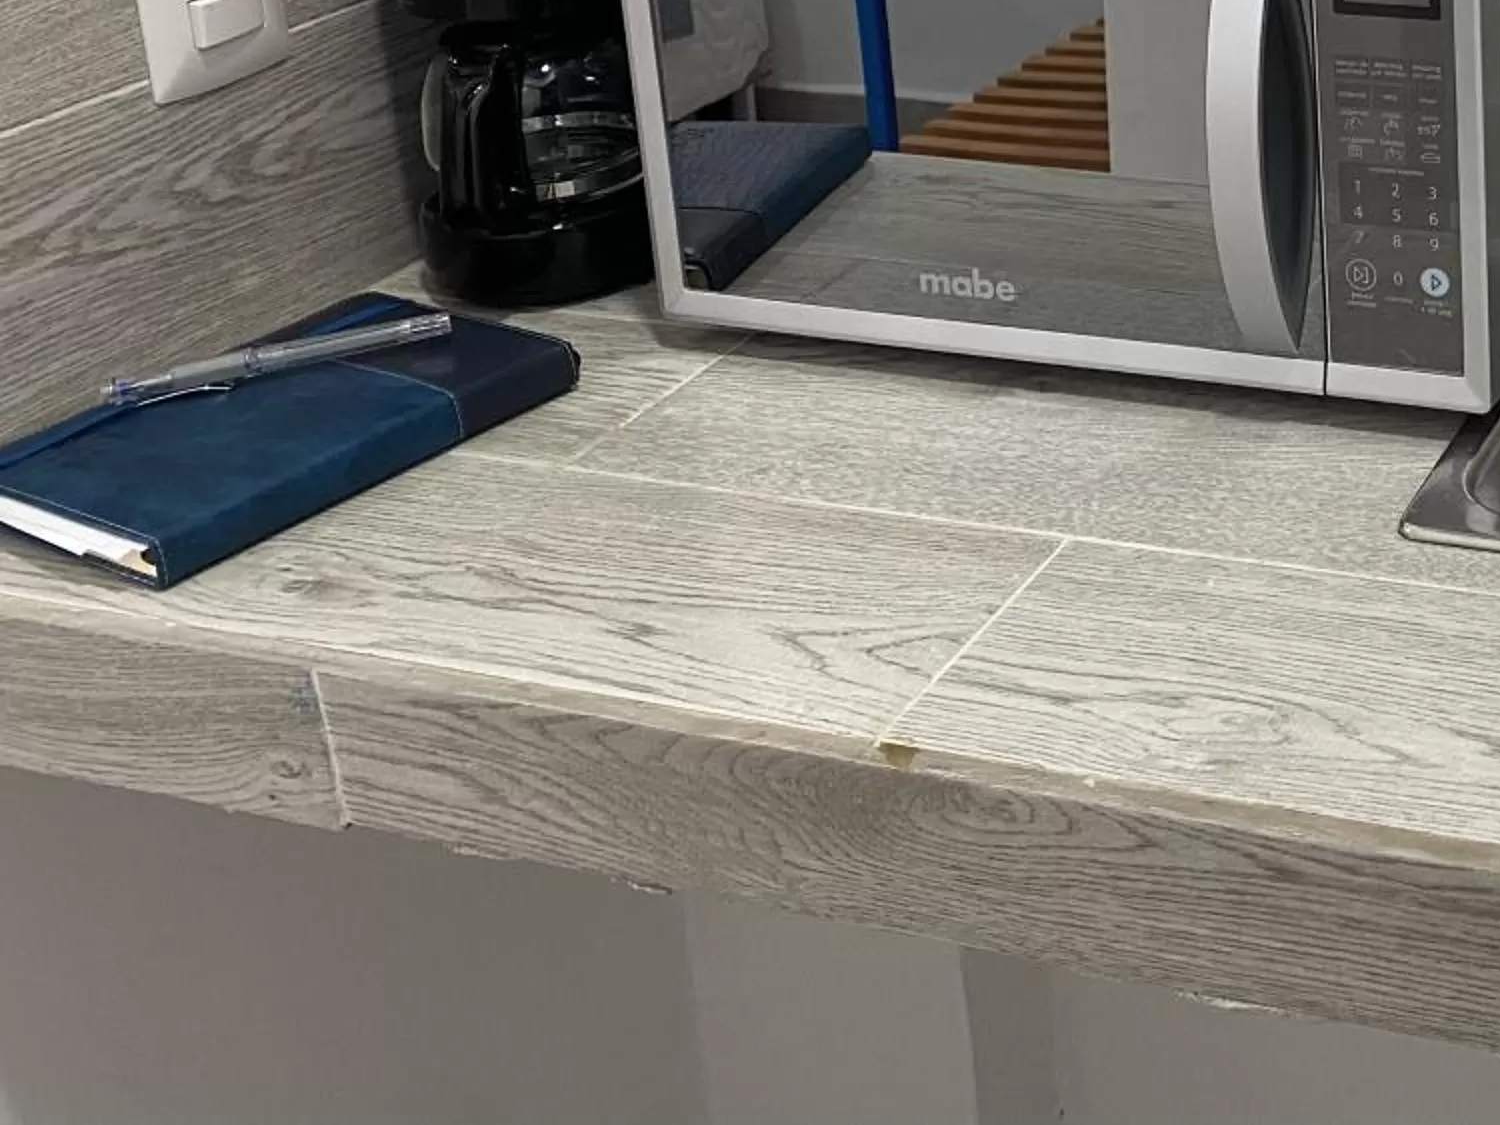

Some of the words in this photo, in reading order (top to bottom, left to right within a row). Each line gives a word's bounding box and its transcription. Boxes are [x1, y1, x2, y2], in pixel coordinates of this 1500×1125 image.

[1391, 182, 1401, 199] 2
[1428, 186, 1438, 201] 3
[1353, 206, 1363, 220] 4
[1391, 207, 1401, 223] 5
[1428, 212, 1439, 227] 6
[1354, 230, 1365, 245] 7
[1392, 234, 1402, 249] 8
[1429, 238, 1439, 252] 9
[920, 266, 1016, 302] mabe
[1393, 270, 1403, 286] 0
